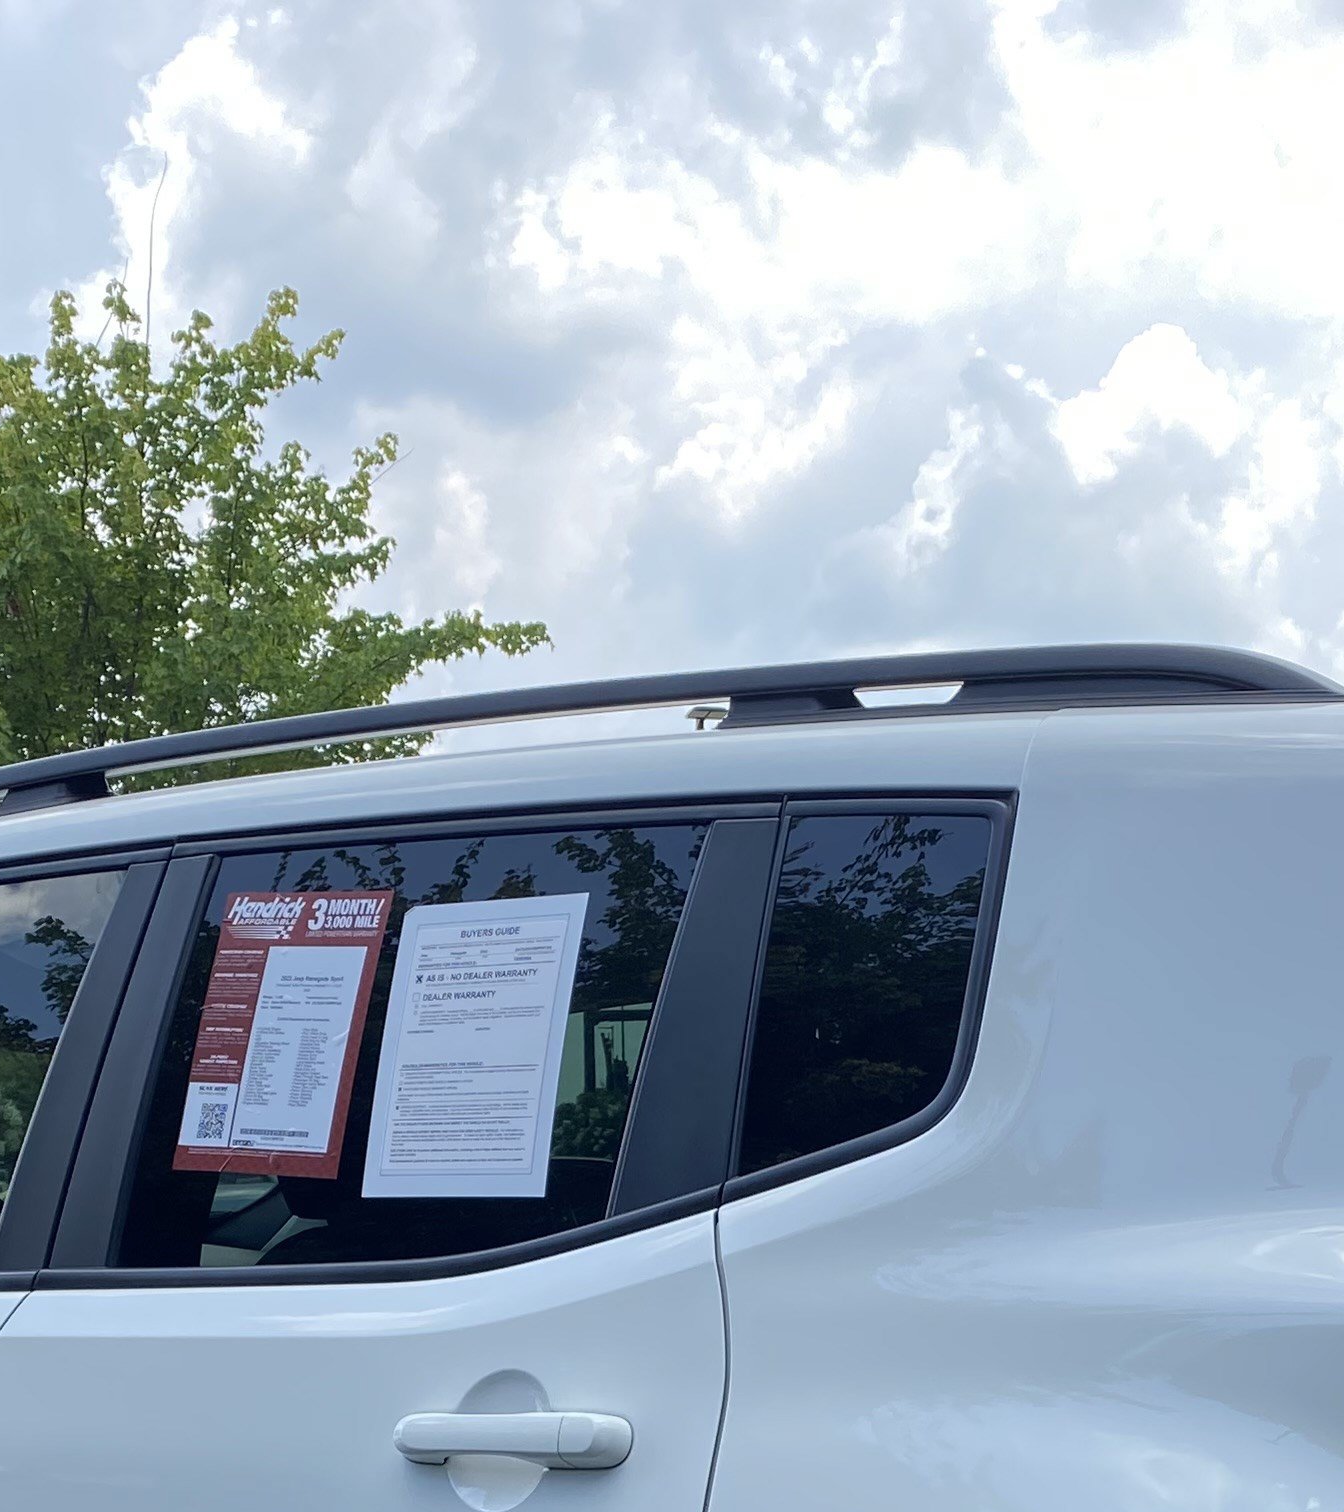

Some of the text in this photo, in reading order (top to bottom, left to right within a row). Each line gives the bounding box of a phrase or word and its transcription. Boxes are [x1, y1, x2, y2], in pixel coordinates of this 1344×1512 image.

[228, 896, 306, 925] Hendrick
[307, 898, 329, 930] 3
[324, 915, 381, 929] 3,000 MILE
[460, 926, 521, 938] BUYERS GUIDE
[426, 974, 436, 982] AS
[450, 973, 462, 981] NO
[463, 971, 493, 981] DEALER
[494, 968, 539, 978] WARRANTY
[422, 990, 497, 1001] DEALER WARRANTY
